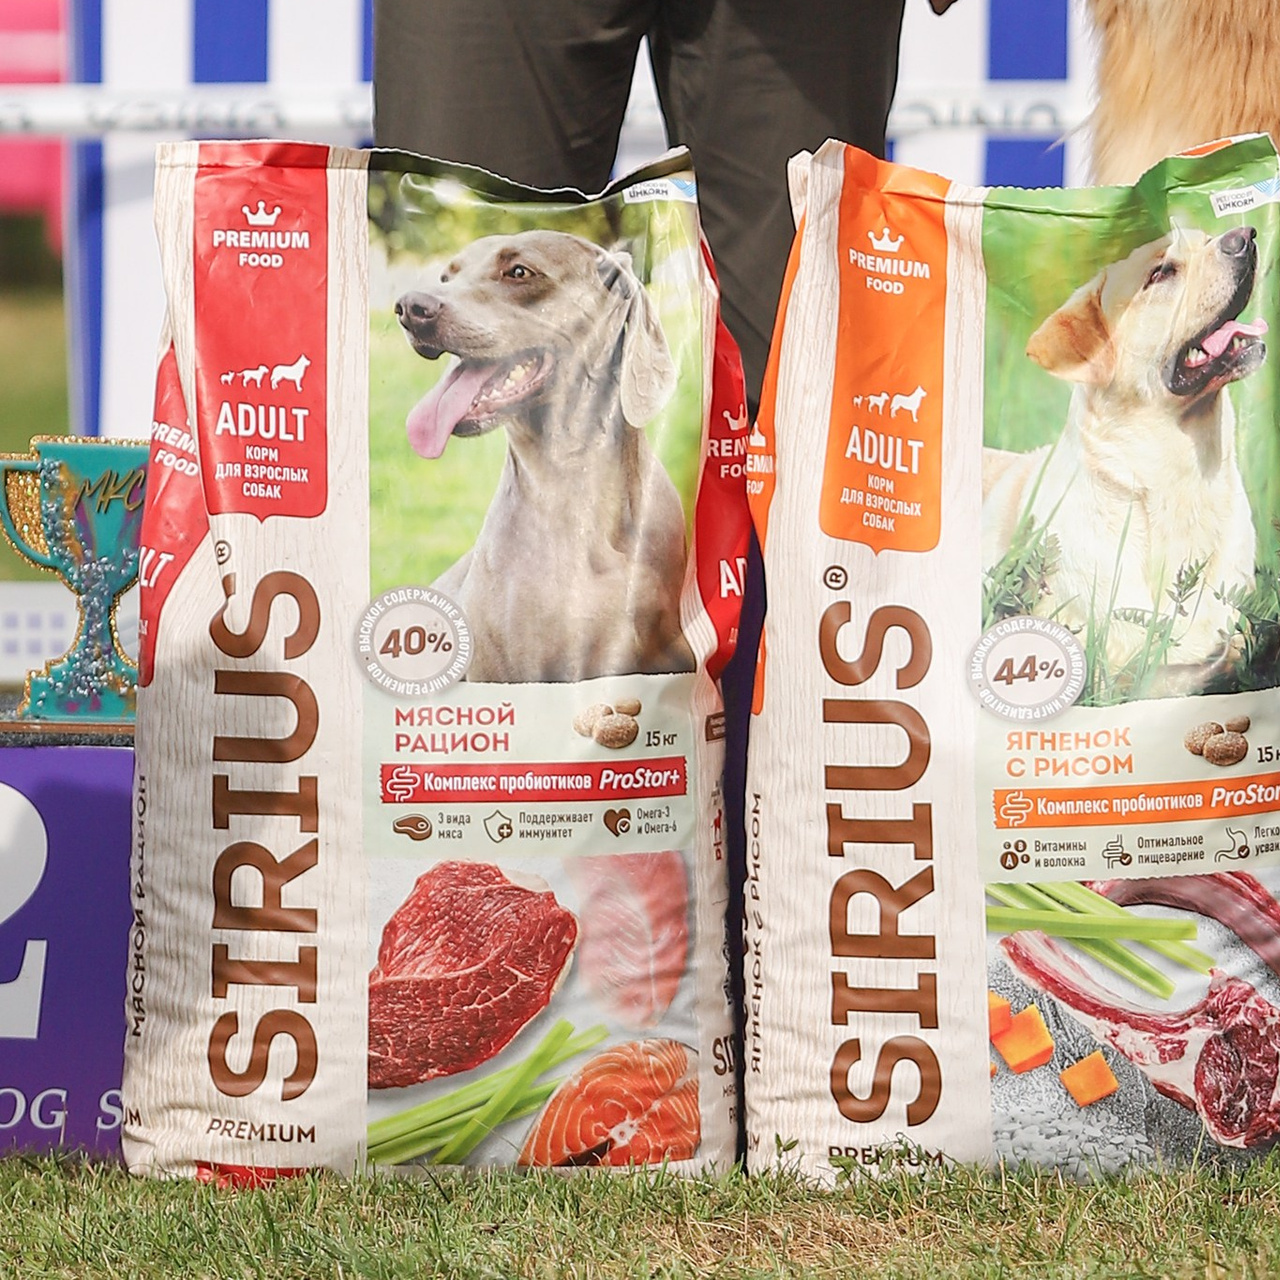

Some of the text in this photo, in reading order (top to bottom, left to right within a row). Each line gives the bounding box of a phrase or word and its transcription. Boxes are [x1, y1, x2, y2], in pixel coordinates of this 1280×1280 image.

[213, 230, 310, 249] PREMIUM
[238, 253, 283, 268] FOOD
[849, 248, 930, 279] PREMIUM
[866, 276, 904, 295] FOOD
[215, 401, 309, 441] ADULT
[245, 445, 279, 463] КОРМ
[845, 425, 924, 474] ADULT
[154, 448, 199, 476] FOOD
[215, 462, 309, 483] ДЛЯ ВЗРОСЛЫХ
[242, 482, 282, 499] СОБАК
[868, 473, 894, 494] КОРМ
[840, 487, 921, 517] ДЛЯ ВЗРОСЛЫХ
[862, 511, 895, 532] СОБАК
[359, 588, 470, 695] ВЫСОКОЕ СОДЕРЖАНИЕ ЖИВОТНЫХ ИНГРЕДИЕНТОВ
[380, 626, 452, 658] 40%
[971, 619, 1083, 719] ВЫСОКОЕ СОДЕРЖАНИЕ ЖИВОТНЫХ ИНГРЕДИЕНТОВ
[993, 655, 1065, 685] 44%
[395, 702, 515, 726] МЯСНОЙ
[395, 732, 509, 754] РАЦИОН
[646, 731, 677, 746] 15 кг
[1006, 727, 1132, 751] ЯГНЕНОК
[1006, 754, 1134, 777] С РИСОМ
[1257, 747, 1272, 763] 15
[424, 767, 680, 794] Комплекс пробиотиков ProStor+
[637, 806, 670, 820] Омега-3
[1037, 793, 1203, 817] Комплекс пробиотиков
[438, 812, 471, 826] 3 вида
[519, 812, 593, 826] Поддерживает
[637, 822, 677, 834] и Омега-6
[207, 570, 320, 1102] SIRIUS
[438, 829, 463, 840] мяса
[519, 827, 573, 840] иммунитет
[1137, 834, 1204, 849] Оптимальное
[1254, 826, 1280, 838] Легко
[1034, 839, 1087, 853] Витамины
[819, 601, 943, 1126] SIRIUS
[1034, 856, 1041, 867] и
[1043, 855, 1086, 867] волокна
[1138, 850, 1205, 866] пищеварение
[0, 1088, 68, 1130] OG
[206, 1118, 316, 1143] PREMIUM
